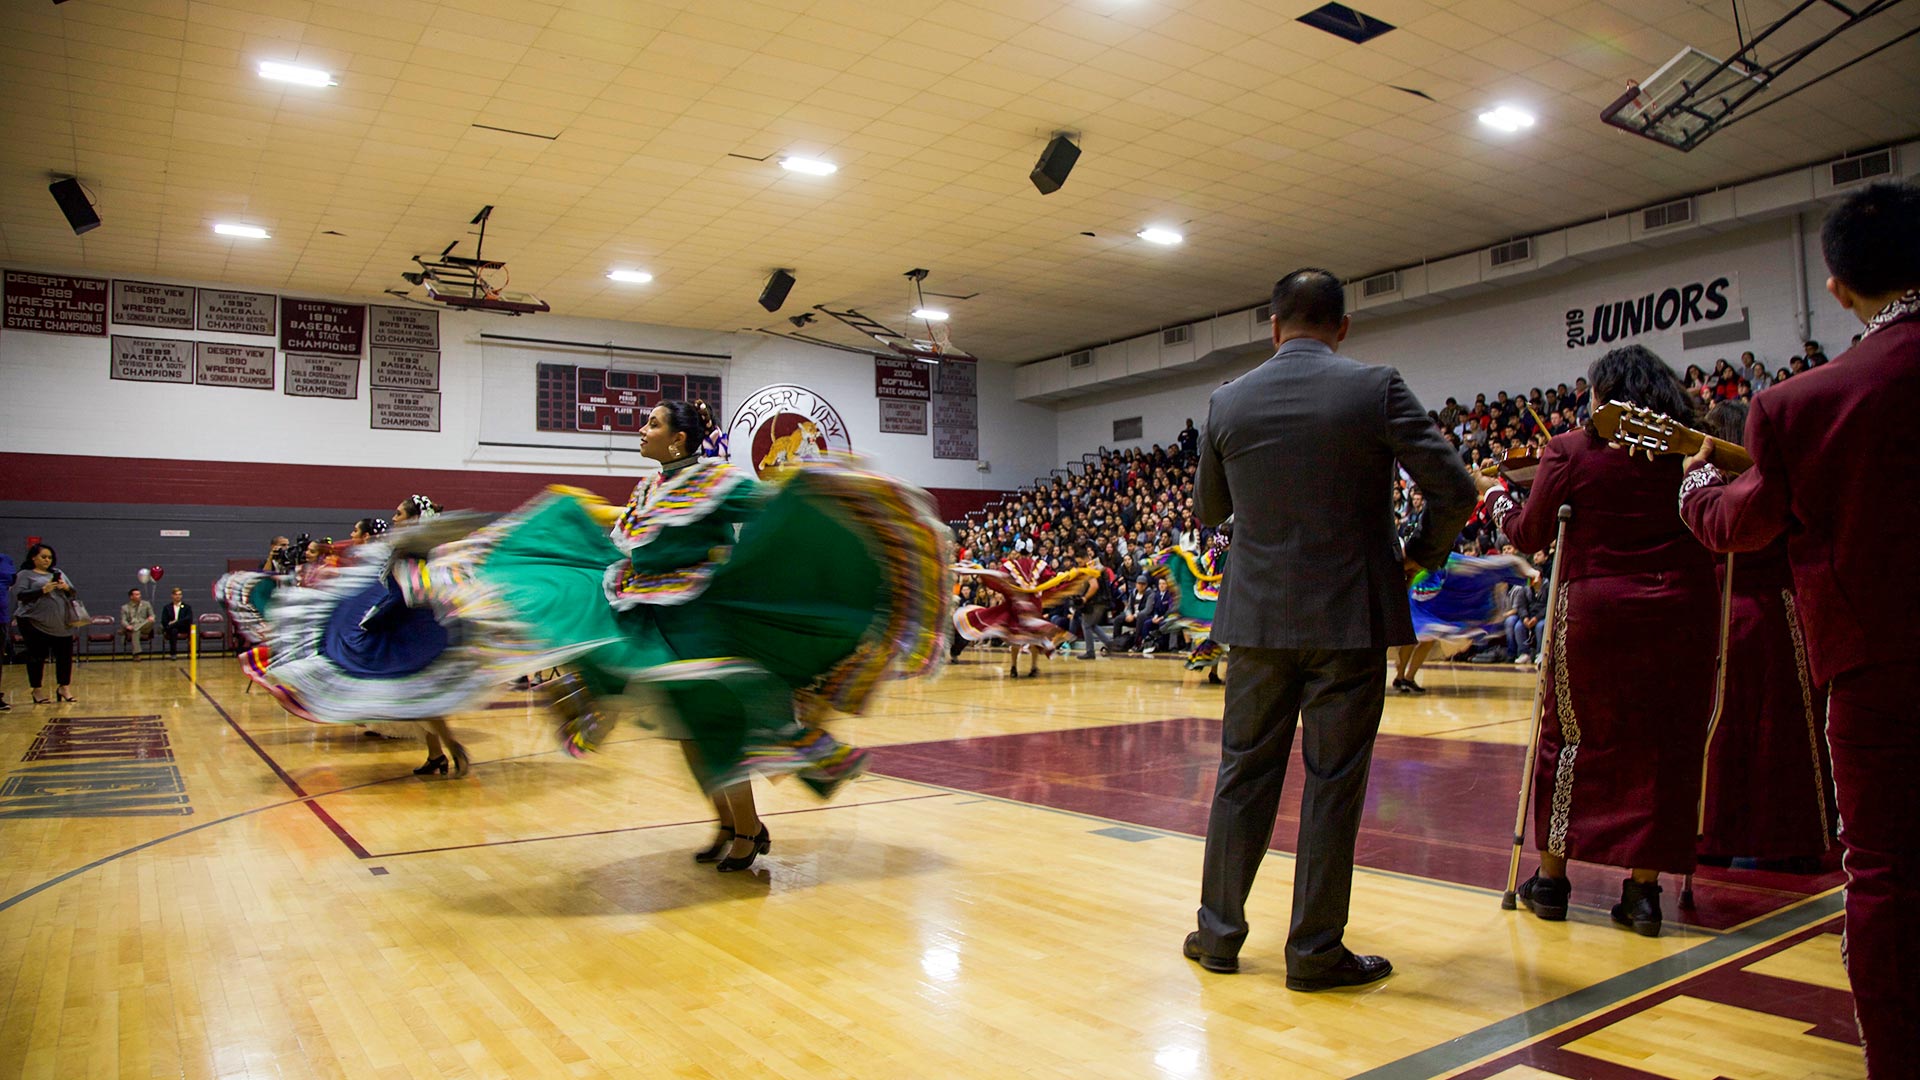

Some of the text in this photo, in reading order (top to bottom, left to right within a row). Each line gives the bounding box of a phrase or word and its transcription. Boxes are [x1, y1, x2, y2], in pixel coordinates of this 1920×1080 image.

[6, 273, 105, 290] DESERT VIEW
[41, 288, 72, 298] 1989
[124, 285, 184, 297] DESERT VIEW
[6, 295, 104, 312] WRESTLING
[143, 296, 166, 305] 1989
[8, 306, 35, 316] CLASS
[122, 304, 186, 315] WRESTLING
[209, 306, 265, 315] BASEBALL
[298, 304, 326, 312] DESERT
[1586, 278, 1729, 345] JUNIORS
[115, 312, 192, 324] 4A SONORAN CHAMPIONS
[8, 317, 102, 333] STATE CHAMPIONS
[207, 321, 266, 332] CHAMPIONS
[290, 320, 356, 334] BASEBALL
[1566, 309, 1585, 348] 2019
[319, 332, 340, 341] STATE
[288, 339, 356, 351] CHAMPIONS
[208, 347, 242, 356] DESERT
[122, 353, 183, 362] BASEBALL
[225, 357, 247, 366] 1990
[381, 361, 429, 371] BASEBALL
[876, 360, 908, 368] DESERT
[122, 368, 182, 378] CHAMPIONS
[205, 365, 266, 375] WRESTLING
[894, 370, 912, 378] 2000
[210, 374, 237, 383] SONORAN
[240, 376, 272, 384] CHAMPIONS
[379, 376, 431, 385] CHAMPIONS
[882, 378, 924, 388] SOFTBALL
[296, 385, 347, 395] CHAMPIONS
[878, 386, 929, 397] STATE CHAMPIONS
[735, 389, 844, 442] DESERT VIEW
[381, 418, 430, 427] CHAMPIONS
